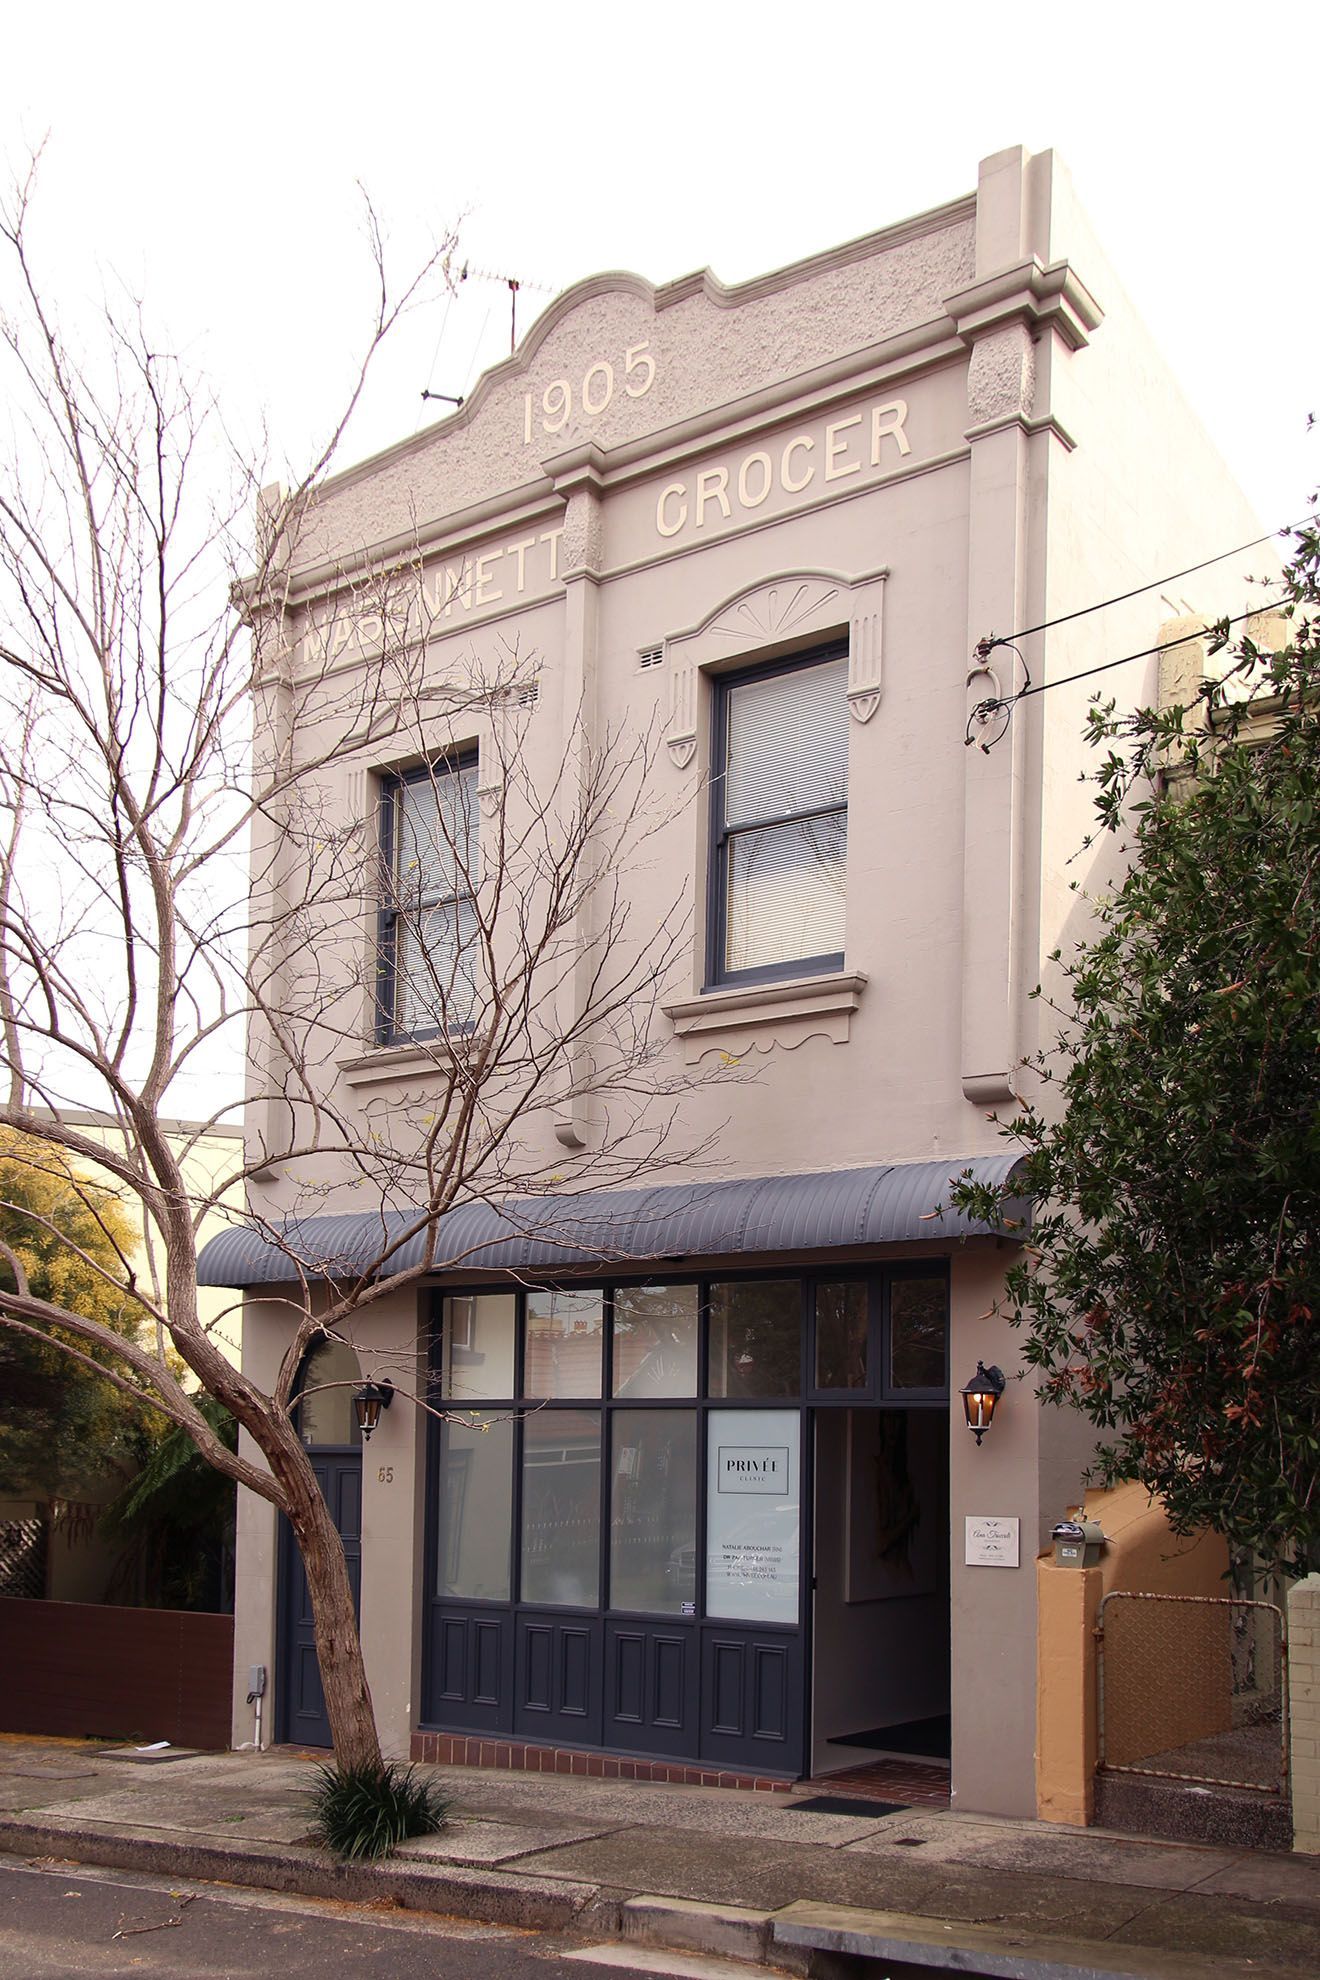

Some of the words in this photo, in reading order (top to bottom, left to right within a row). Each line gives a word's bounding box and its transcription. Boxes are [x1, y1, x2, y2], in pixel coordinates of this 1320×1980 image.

[524, 340, 656, 444] 1905
[727, 1457, 779, 1472] PRIVÉE
[378, 1466, 394, 1484] 65
